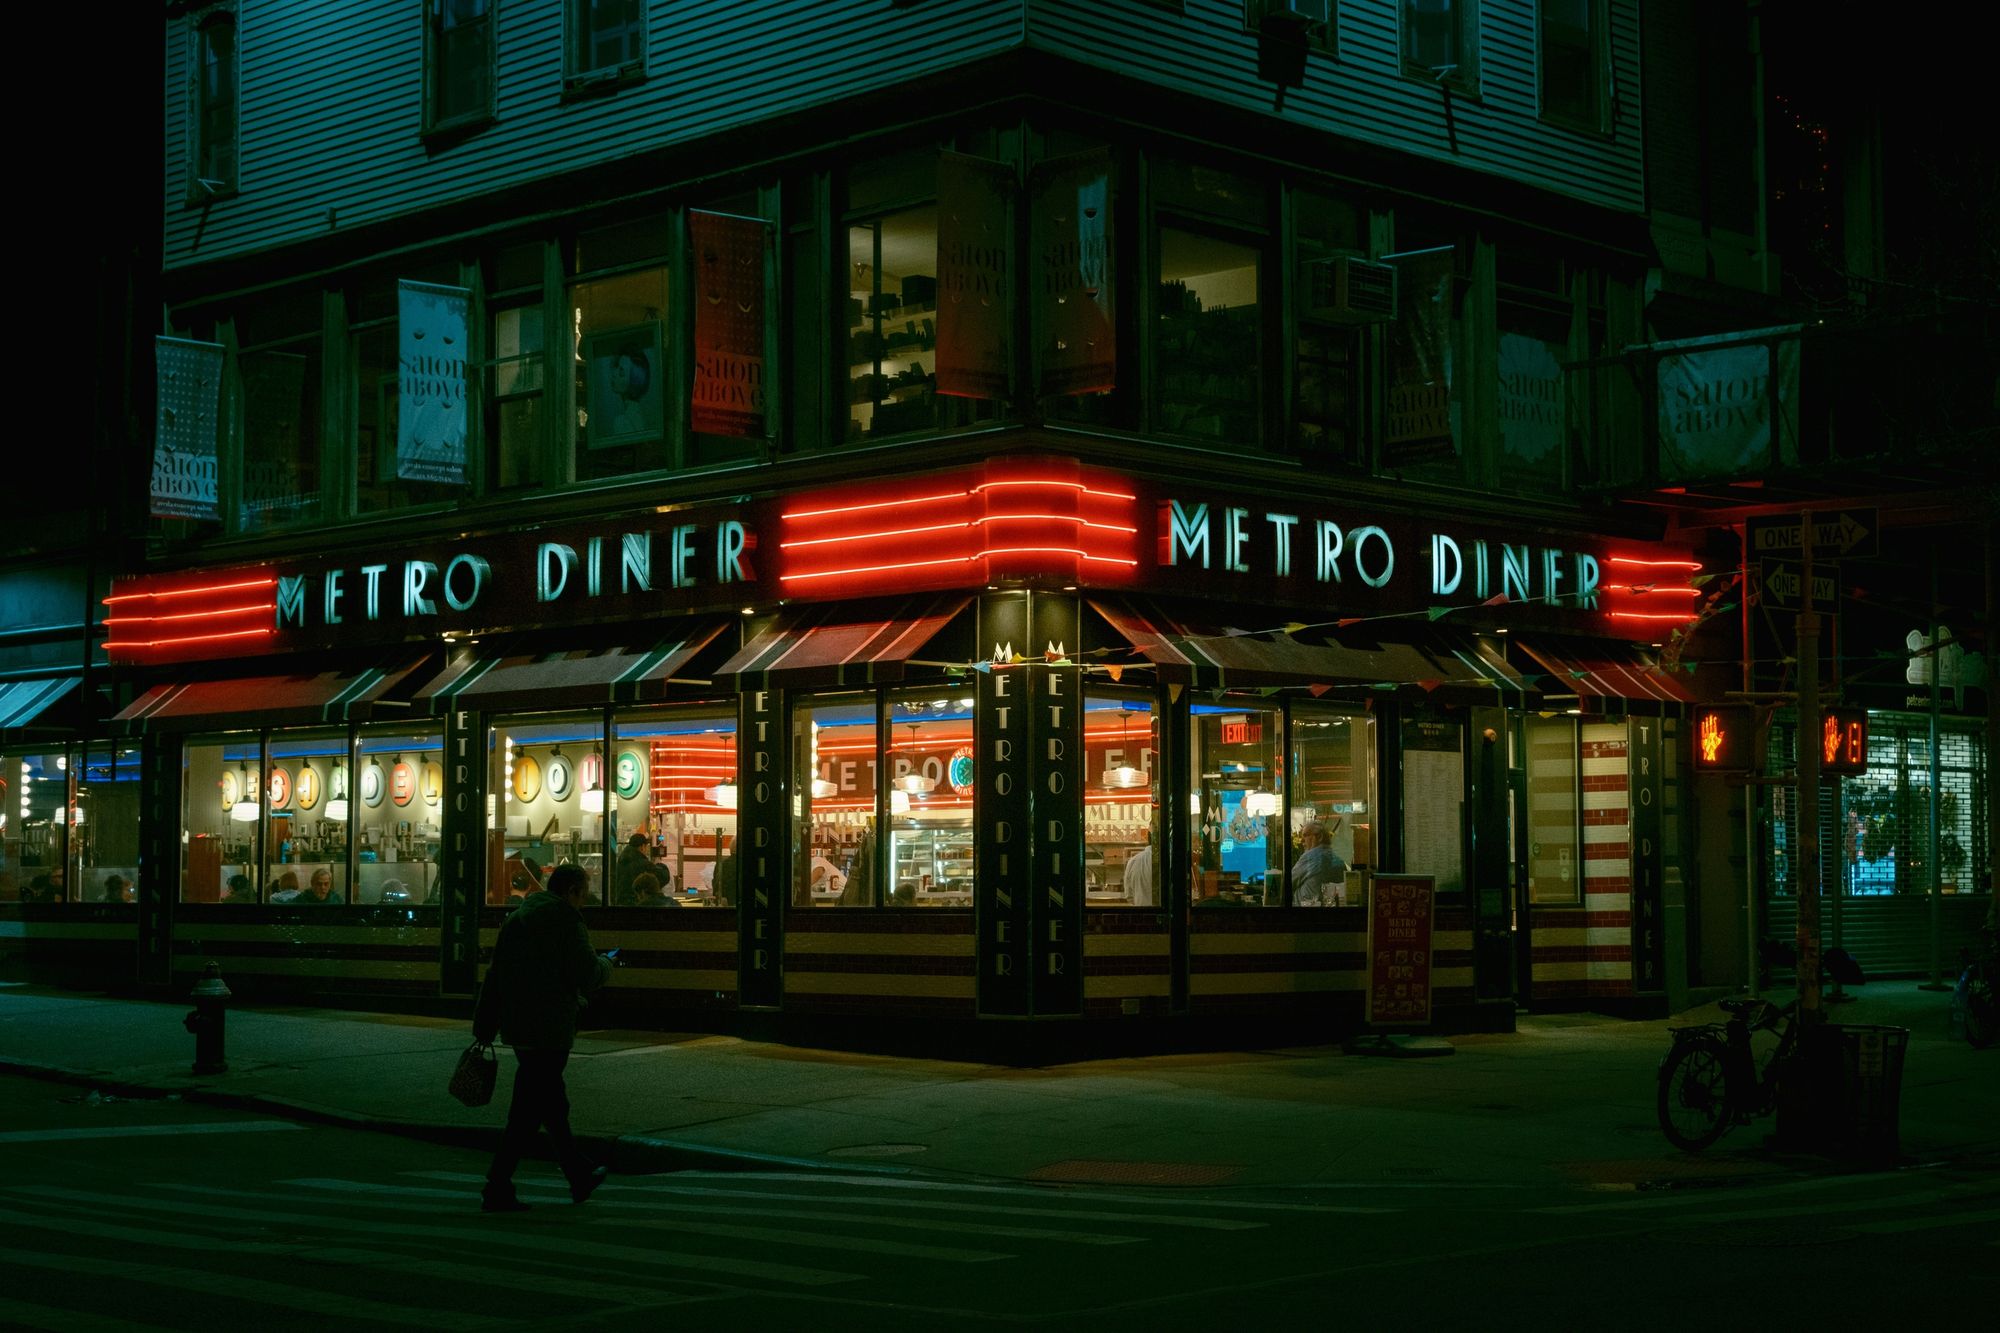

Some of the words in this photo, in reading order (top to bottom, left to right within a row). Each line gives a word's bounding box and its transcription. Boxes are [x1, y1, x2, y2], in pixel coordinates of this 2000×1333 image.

[152, 455, 216, 480] salon
[276, 553, 490, 630] METRO
[536, 519, 750, 603] DINER
[1168, 499, 1395, 590] METRO
[1432, 533, 1600, 610] DINER
[1764, 527, 1801, 547] ONE
[1818, 523, 1856, 545] WAY
[1774, 575, 1796, 594] ONE
[1813, 579, 1830, 598] AY
[455, 710, 470, 813] ETRO
[754, 691, 770, 804] ETRO
[992, 640, 1014, 796] METRO
[1047, 639, 1066, 795] METRO
[1227, 724, 1246, 744] EXIT
[1639, 725, 1651, 806] TRO
[361, 759, 635, 800] DELIOUS
[453, 831, 468, 961] DINER
[753, 826, 770, 971] DINER
[994, 820, 1013, 976] DINER
[1047, 819, 1066, 976] DINER
[1388, 918, 1417, 927] METRO
[1388, 927, 1417, 938] DINER
[1641, 838, 1655, 980] DINER
